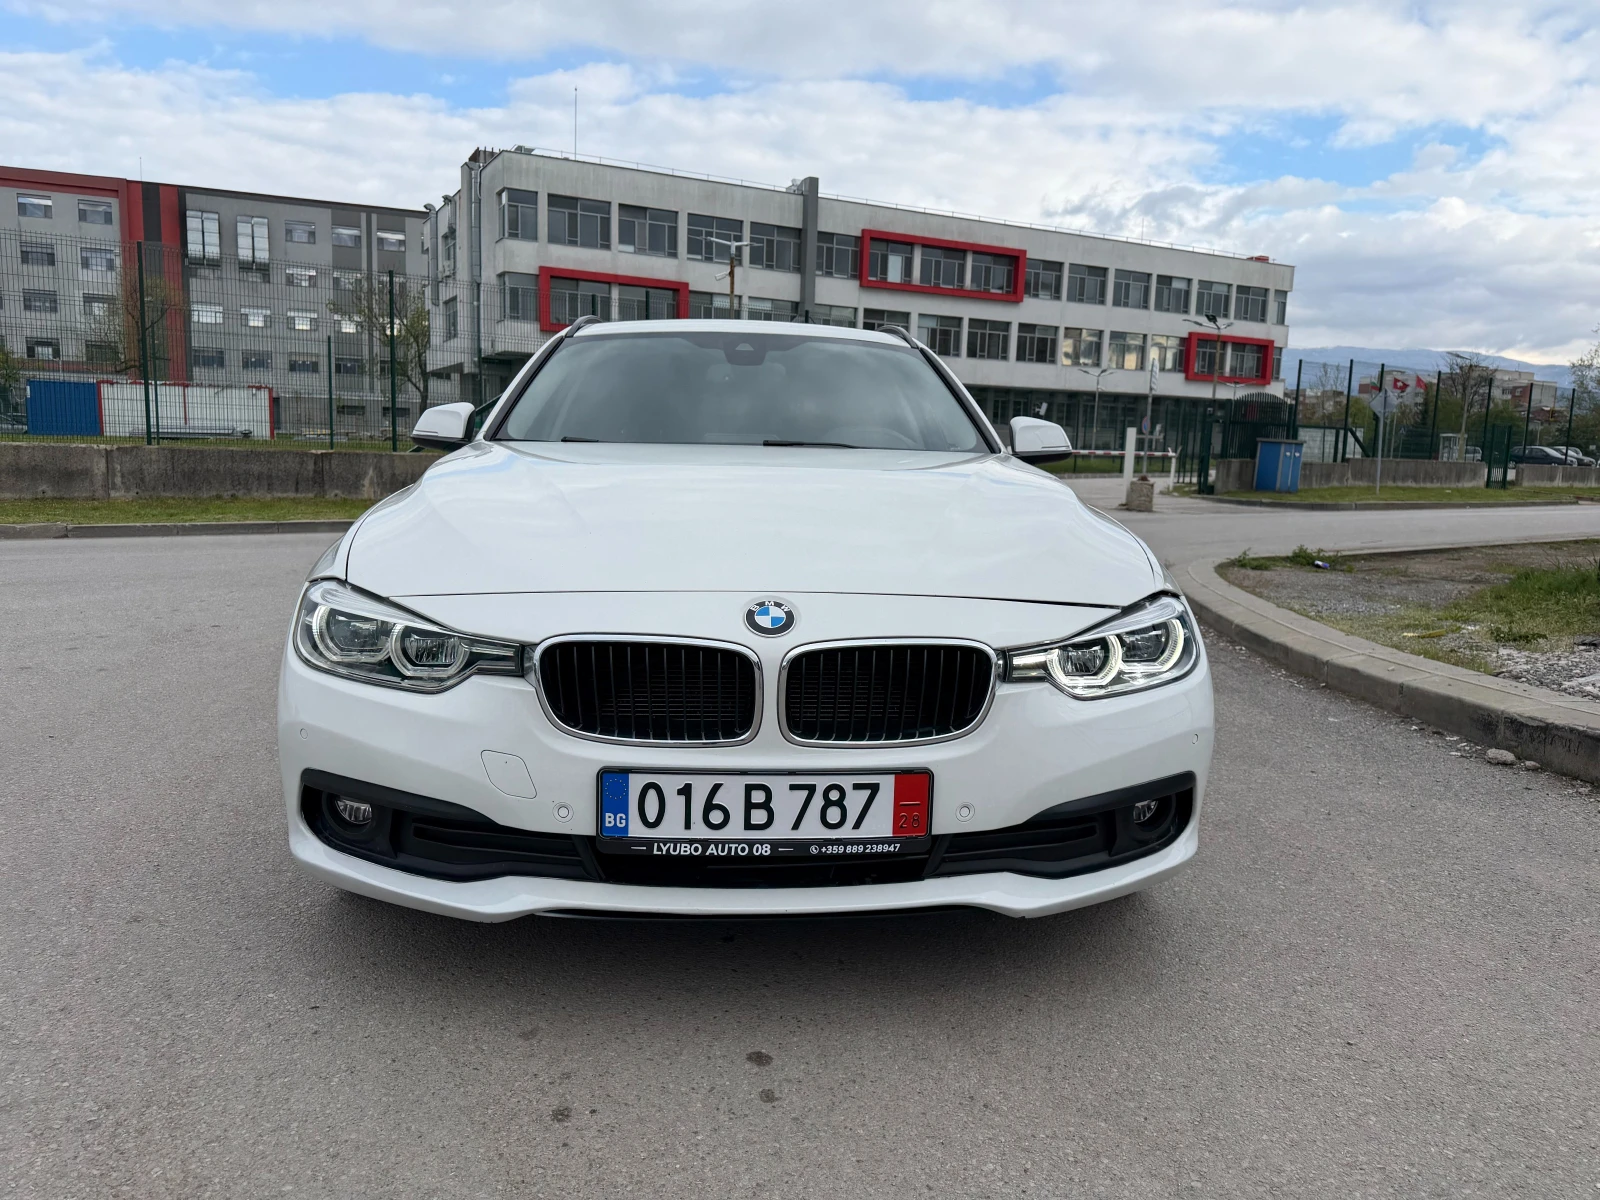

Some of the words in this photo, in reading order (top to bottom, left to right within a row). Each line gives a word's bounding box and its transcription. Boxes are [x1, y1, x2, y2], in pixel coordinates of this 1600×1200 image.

[750, 600, 791, 612] BMW
[604, 812, 627, 828] BG
[899, 812, 920, 829] 28
[653, 842, 703, 856] LYUBO
[705, 843, 749, 856] AUTO
[752, 843, 771, 856] 08
[820, 844, 845, 854] +359
[846, 844, 864, 854] 889
[865, 843, 901, 854] 238947
